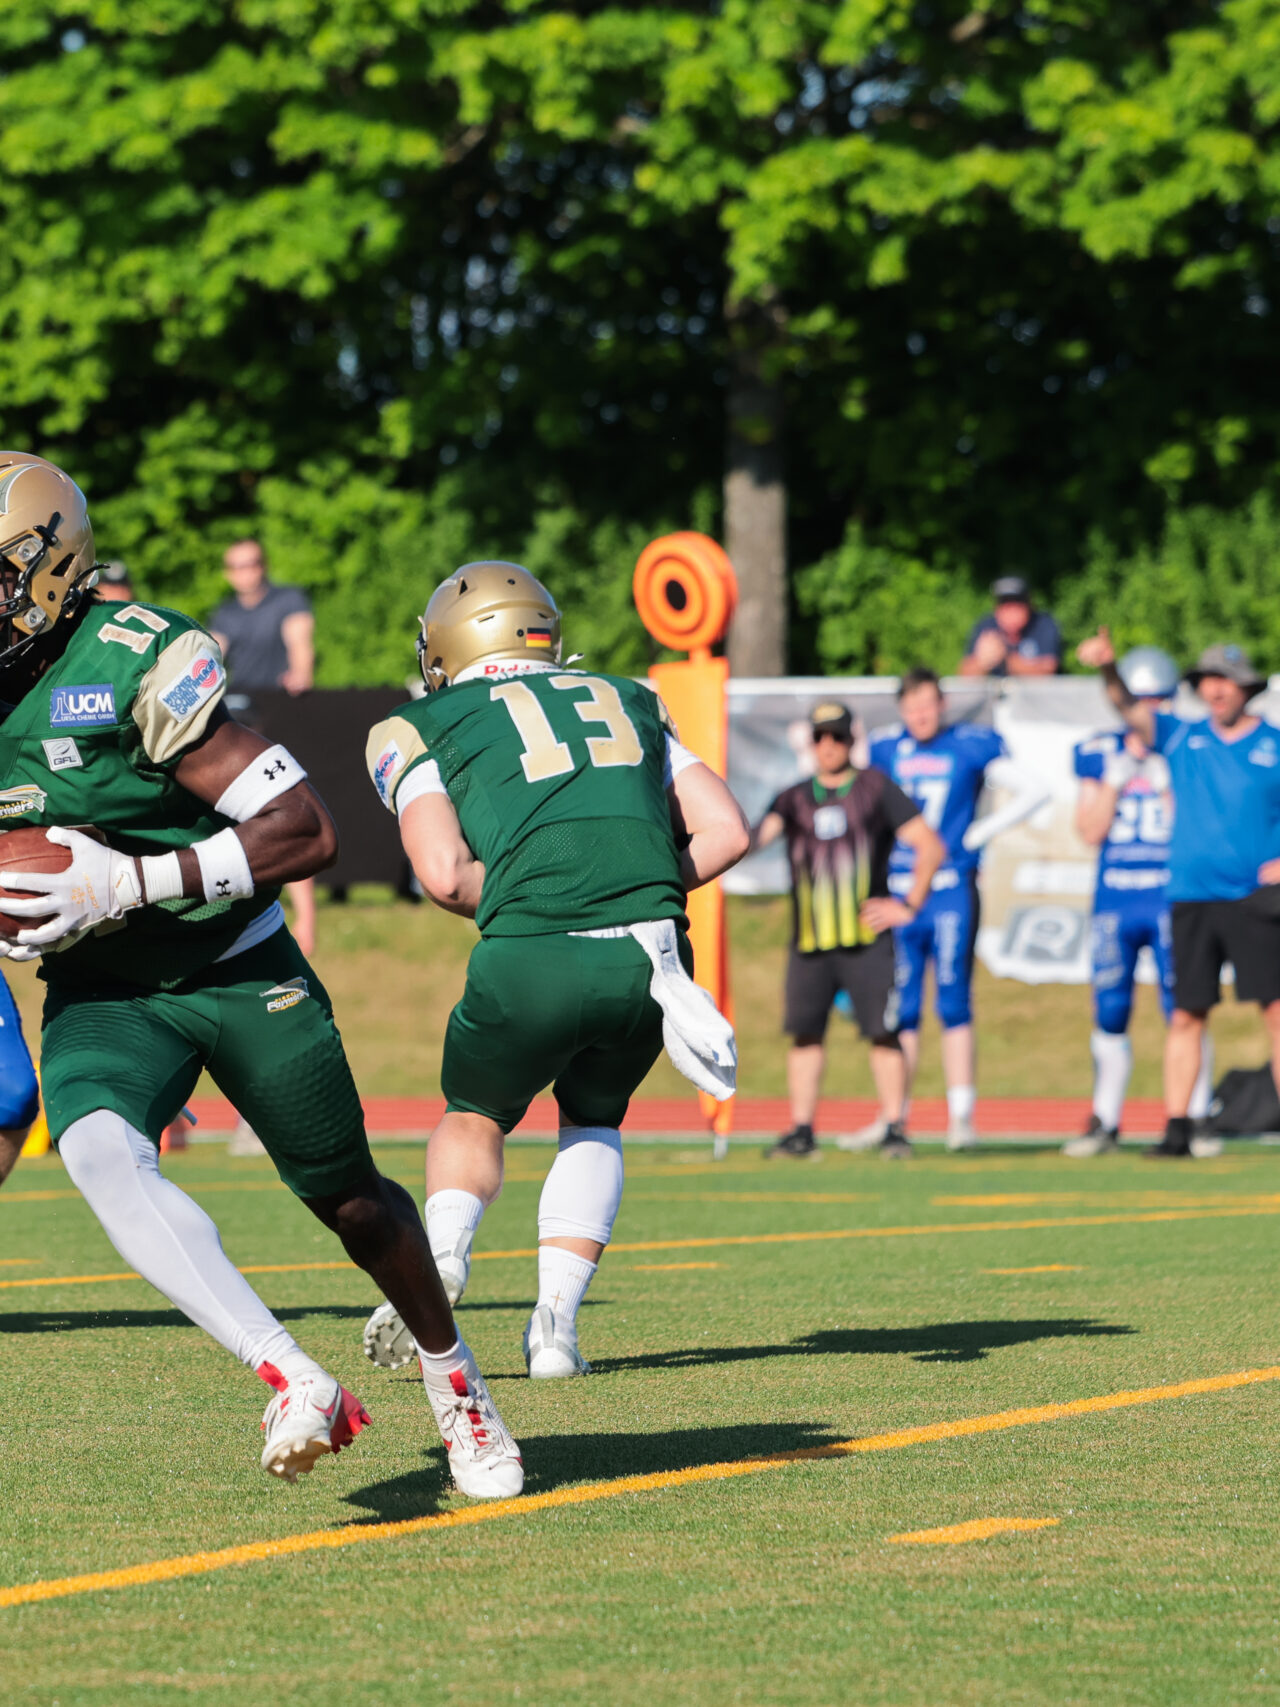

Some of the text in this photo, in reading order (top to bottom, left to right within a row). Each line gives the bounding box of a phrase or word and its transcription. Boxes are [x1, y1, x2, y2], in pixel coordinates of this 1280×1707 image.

[97, 604, 170, 654] 17
[68, 692, 114, 715] UCM
[490, 675, 644, 783] 13
[53, 756, 77, 766] GFL
